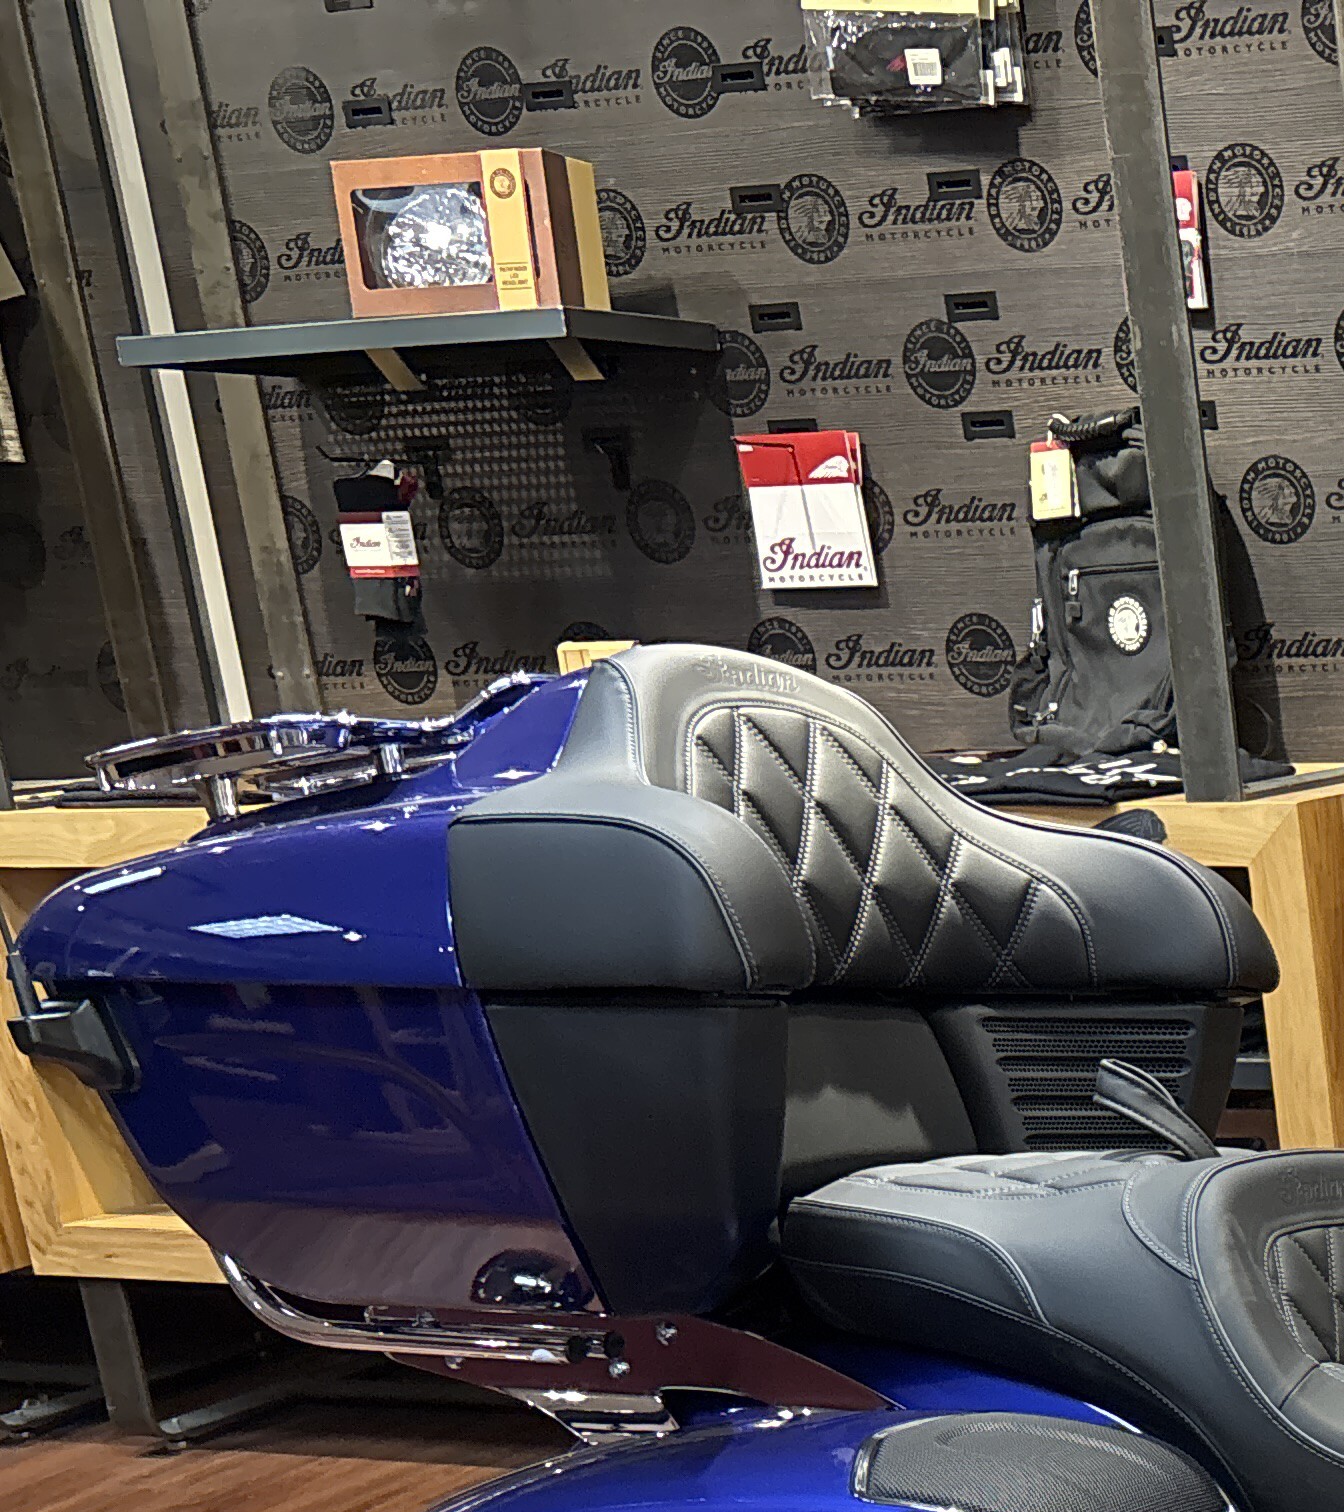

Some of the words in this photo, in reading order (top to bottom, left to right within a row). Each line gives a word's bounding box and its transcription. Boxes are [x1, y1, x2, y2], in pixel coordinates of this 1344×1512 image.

[1172, 1, 1290, 43] Indian
[653, 61, 712, 84] India
[655, 202, 766, 242] Indian
[858, 188, 974, 232] Indian
[985, 335, 1102, 376] Indian
[1200, 323, 1323, 363] Indian
[780, 345, 893, 384] Indian
[905, 349, 972, 373] Indian
[1206, 365, 1321, 378] MOTORCYCLE
[786, 384, 893, 397] MOTORCYCLE
[992, 374, 1102, 387] MOTORCYCLE
[903, 488, 1016, 526] Indian
[909, 527, 1016, 539] MOTORCYCLE
[763, 537, 863, 572] Indian
[768, 573, 863, 583] MOTORCYCLE
[825, 634, 936, 669] Indian
[947, 638, 1014, 663] Indian
